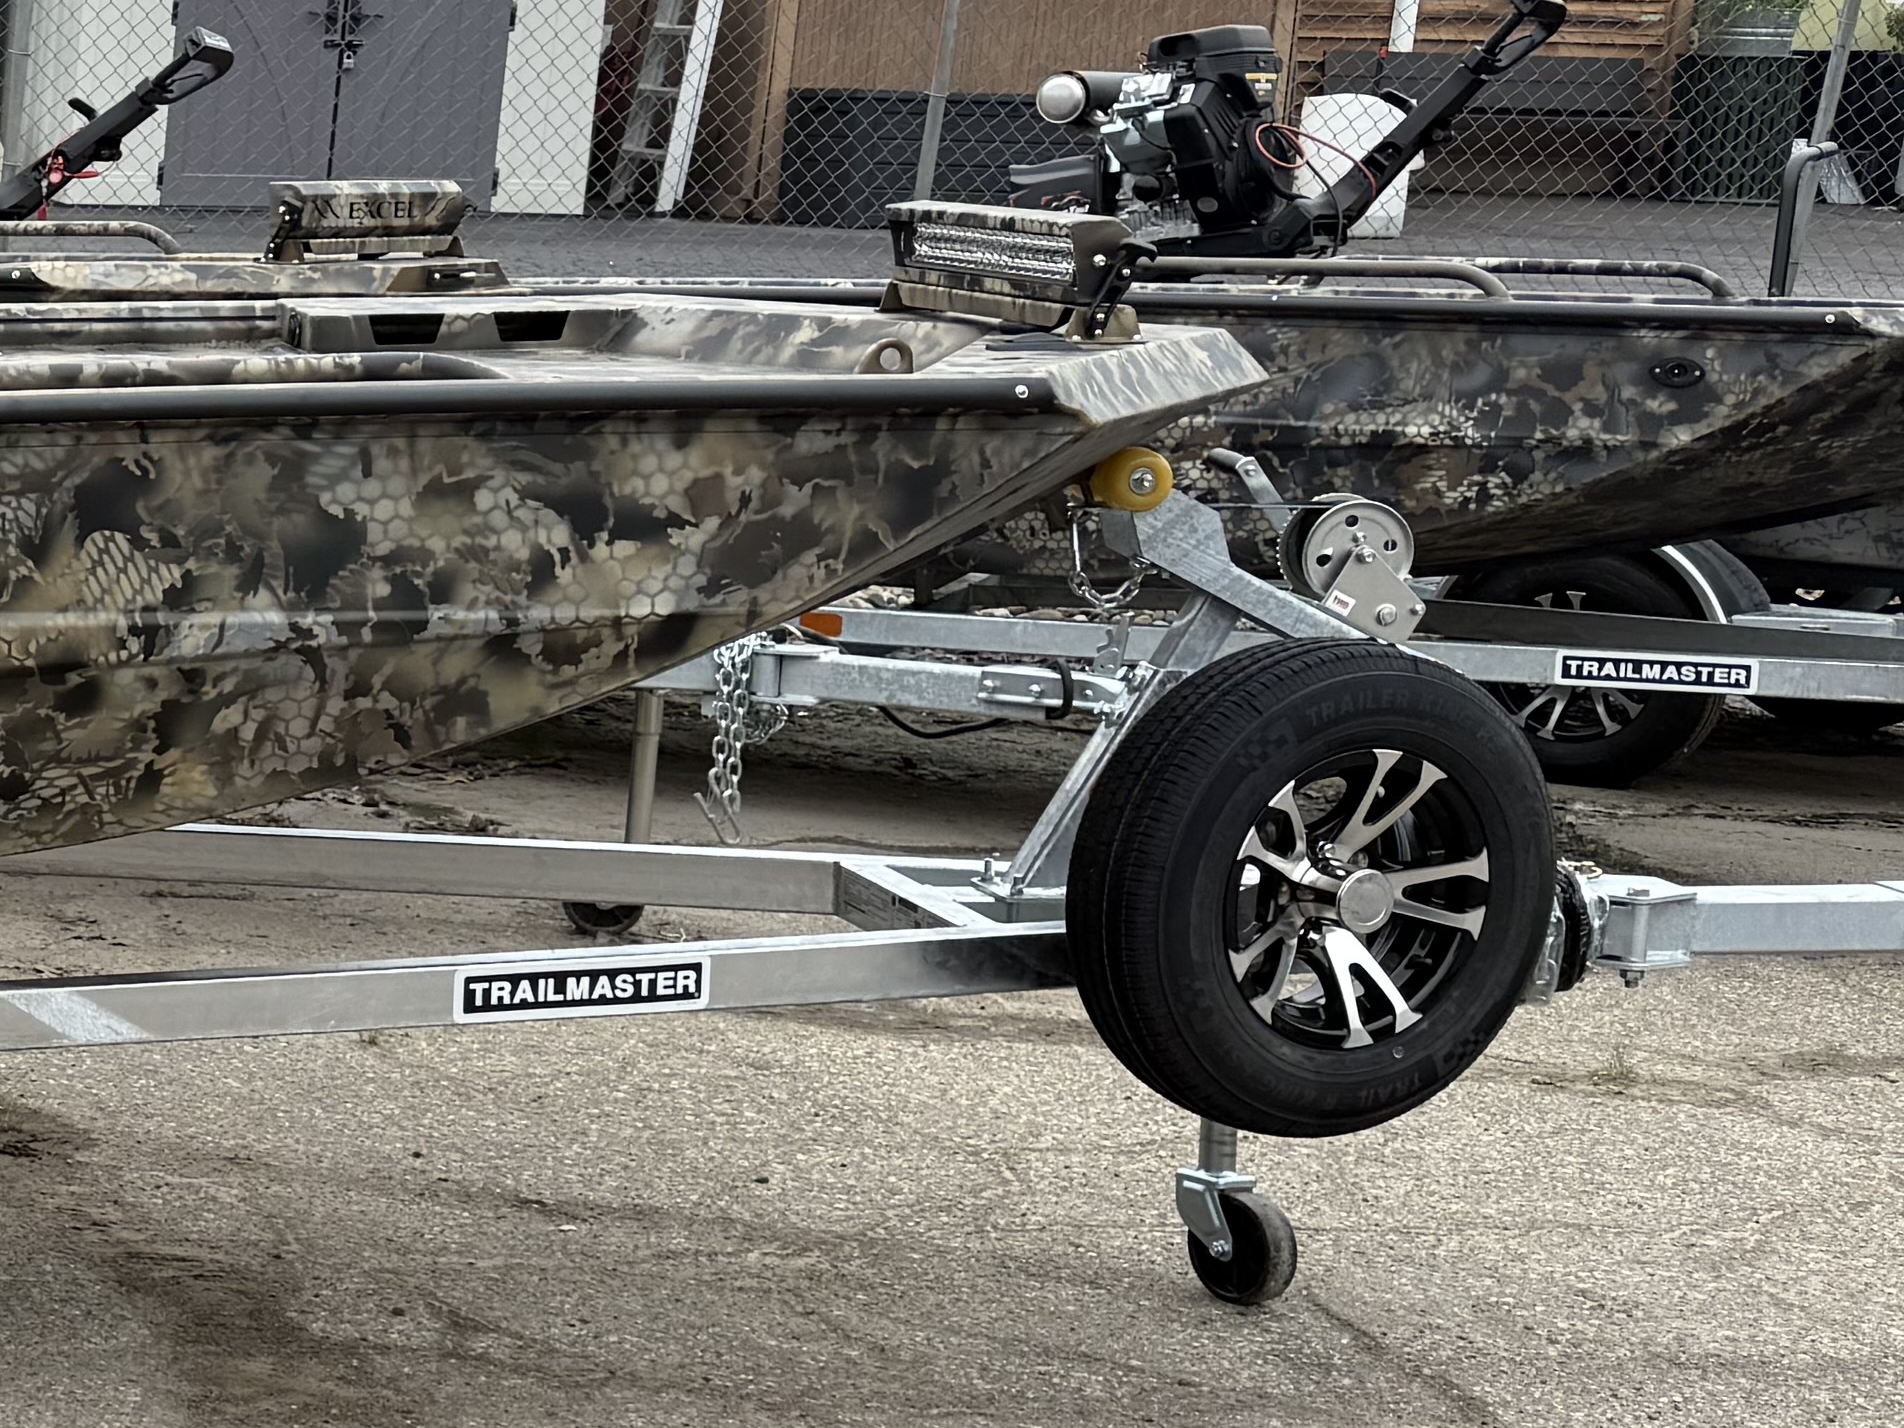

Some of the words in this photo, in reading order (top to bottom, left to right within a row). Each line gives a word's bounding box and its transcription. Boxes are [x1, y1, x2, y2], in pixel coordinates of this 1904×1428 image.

[348, 200, 418, 220] EXCEL
[1565, 659, 1748, 685] TRAILMASTER
[468, 969, 697, 1007] TRAILMASTER
